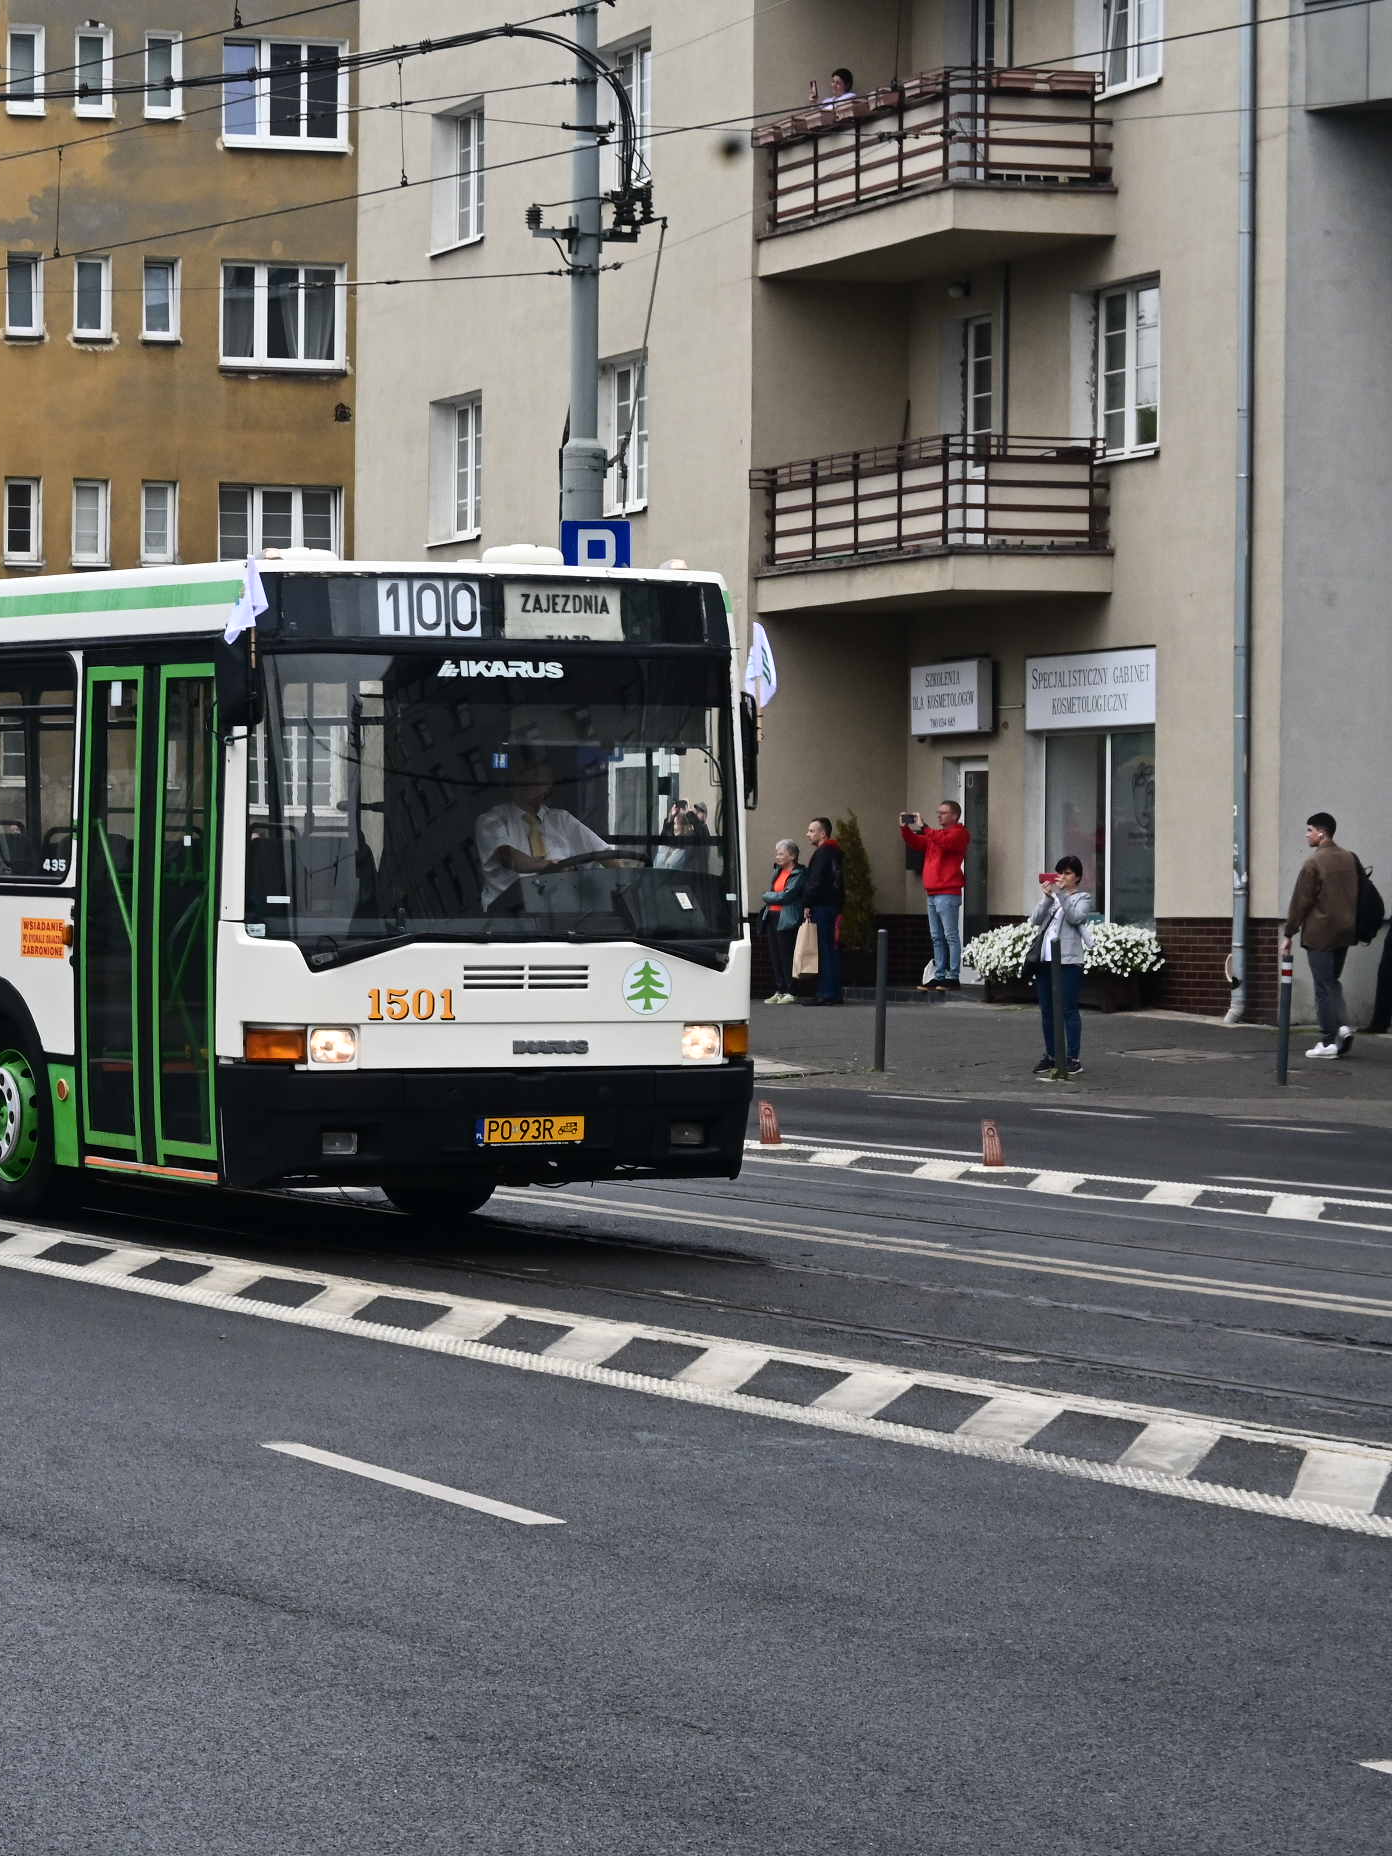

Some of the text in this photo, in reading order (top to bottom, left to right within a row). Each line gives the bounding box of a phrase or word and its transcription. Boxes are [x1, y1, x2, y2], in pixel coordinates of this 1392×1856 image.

[578, 528, 616, 567] P
[385, 582, 478, 632] 100
[520, 593, 610, 615] ZAJEZDNIA
[458, 659, 564, 679] IKARUS
[1112, 664, 1150, 684] GABINET
[1051, 693, 1128, 715] KOSMETOLOGICZNY
[42, 858, 66, 872] 435
[23, 920, 64, 931] WSIADANIE
[23, 945, 64, 956] ZABRONIONE
[367, 988, 456, 1021] 1501
[488, 1118, 554, 1141] PO 93R
